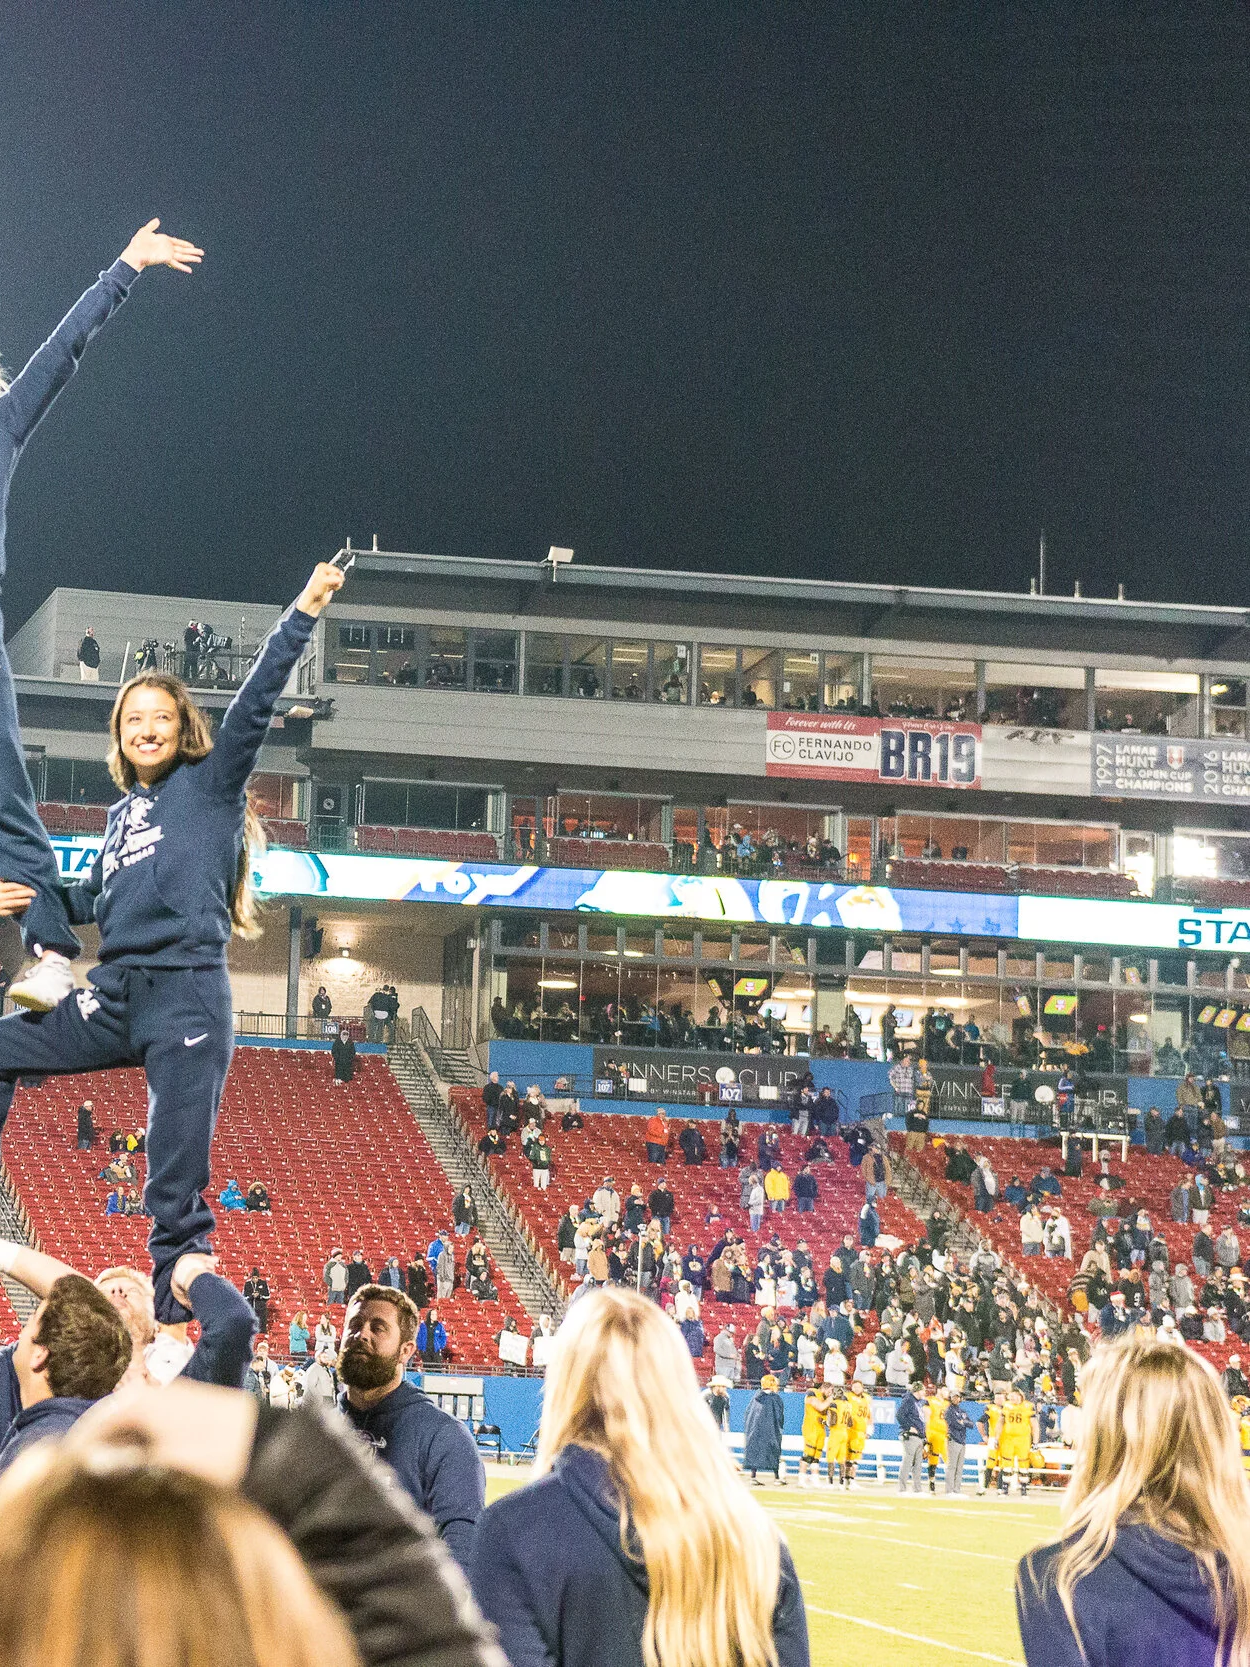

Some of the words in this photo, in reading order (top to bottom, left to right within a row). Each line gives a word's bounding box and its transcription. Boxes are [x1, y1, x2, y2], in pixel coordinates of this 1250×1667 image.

[785, 716, 820, 728] Forever
[820, 719, 842, 730] with
[773, 740, 793, 754] FC
[798, 737, 872, 752] FERNANDO
[1115, 744, 1158, 756] LAMAR
[798, 749, 854, 762] CLAVIJO
[879, 728, 978, 784] BR19
[1115, 755, 1158, 769] HUNT
[1096, 743, 1113, 787] 1997
[1115, 768, 1136, 778] U.S.
[1138, 769, 1169, 780] OPEN
[1170, 771, 1193, 781] CUP
[1203, 750, 1219, 795] 2016
[1115, 778, 1194, 793] CHAMPIONS
[324, 1025, 337, 1033] 108
[597, 1083, 611, 1093] 107
[721, 1088, 740, 1101] 107
[983, 1102, 1003, 1115] 106
